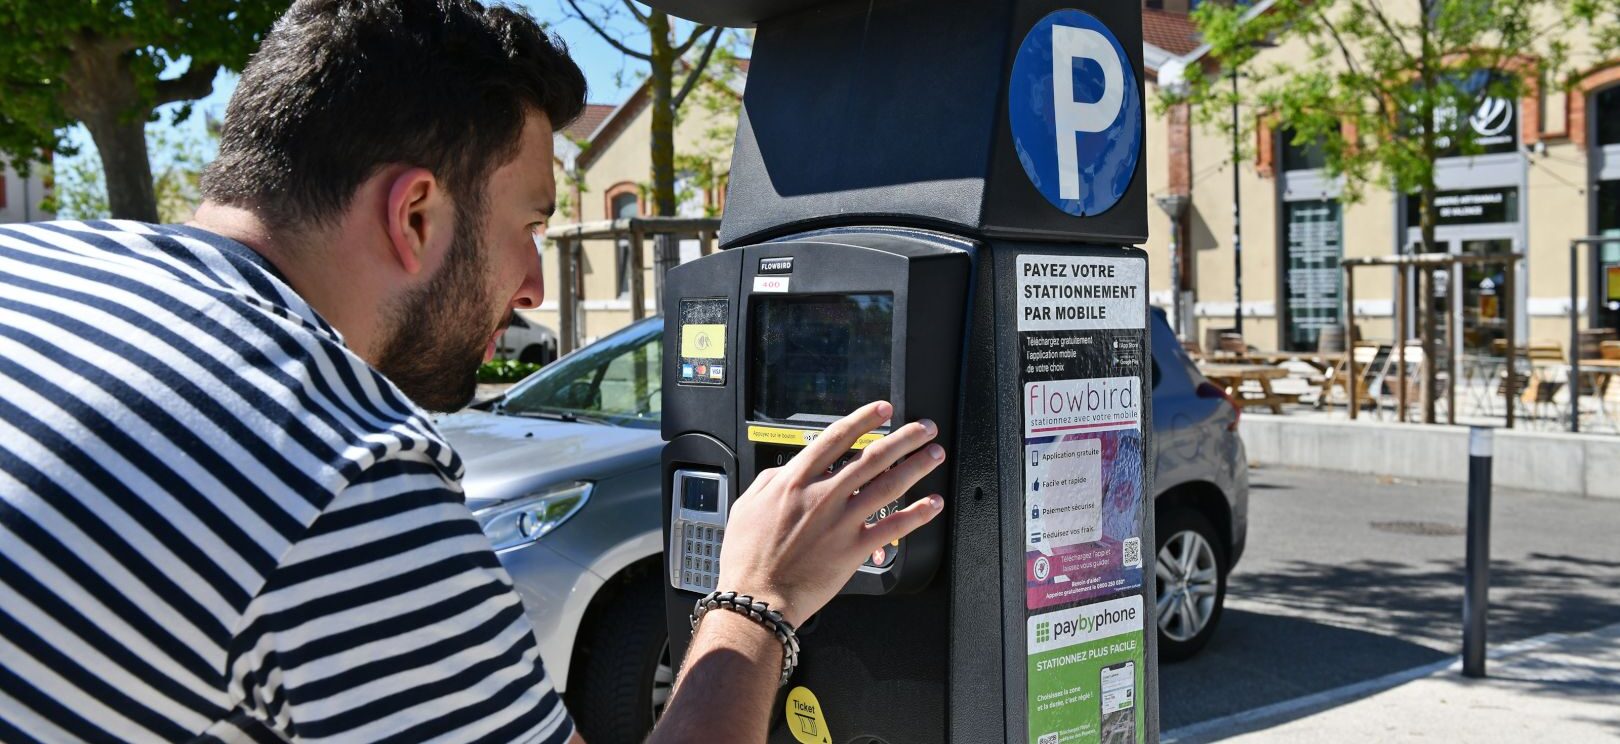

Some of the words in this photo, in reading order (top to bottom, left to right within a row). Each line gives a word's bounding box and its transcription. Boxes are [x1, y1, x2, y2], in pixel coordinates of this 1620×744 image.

[1052, 24, 1124, 200] P
[761, 262, 792, 270] FLOWBIRD
[1024, 263, 1067, 277] PAYEZ
[1071, 264, 1115, 278] VOTRE
[1024, 284, 1137, 299] STATIONNEMENT
[1024, 306, 1051, 320] PAR
[1055, 306, 1106, 320] MOBILE
[1027, 336, 1060, 347] Téléchargez
[1061, 335, 1093, 347] gratuitement
[1027, 350, 1058, 361] l'application
[1059, 349, 1076, 358] mobile
[1027, 364, 1034, 373] de
[1035, 364, 1049, 372] votre
[1050, 362, 1064, 372] choix
[1031, 416, 1071, 427] stationnez
[1073, 415, 1091, 423] avec
[1092, 412, 1111, 421] votre
[1114, 411, 1138, 420] mobile
[1042, 451, 1076, 461] Application
[1077, 448, 1100, 458] gratuite
[1042, 480, 1060, 488] Facile
[1068, 477, 1087, 486] rapide
[1042, 506, 1071, 515] Paiement
[1072, 501, 1095, 511] sécurisé
[1042, 529, 1069, 539] Réduisez
[1061, 552, 1092, 563] Téléchargez
[1064, 586, 1091, 596] gratuitement
[1054, 607, 1136, 640] paybyphone
[1037, 651, 1087, 671] STATIONNEZ
[1089, 646, 1108, 659] PLUS
[1110, 640, 1136, 654] FACILE
[1037, 690, 1063, 701] Choisissez
[1069, 686, 1081, 694] zone
[793, 700, 815, 714] Ticket
